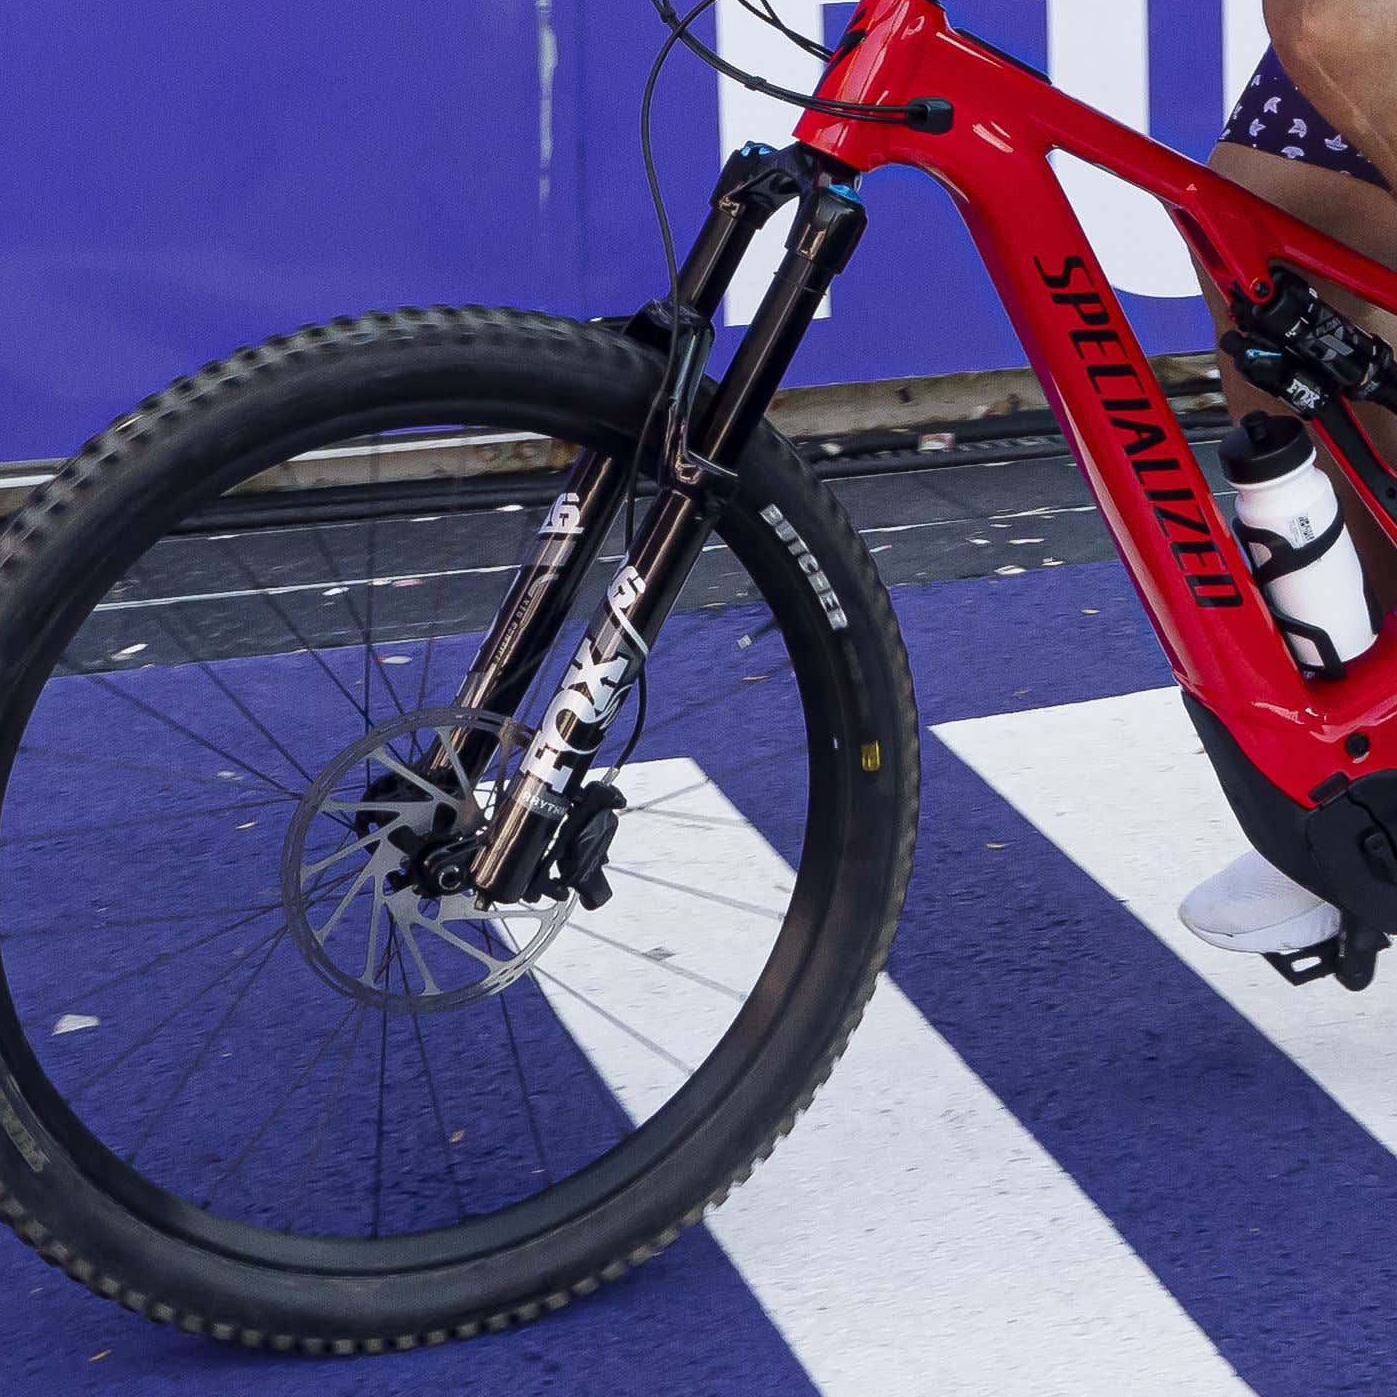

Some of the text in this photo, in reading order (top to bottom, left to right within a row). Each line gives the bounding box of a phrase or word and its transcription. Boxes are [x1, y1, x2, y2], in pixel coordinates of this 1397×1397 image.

[1034, 255, 1243, 609] SPECIALIZED
[1286, 378, 1320, 410] FOX
[759, 504, 850, 632] BUTCHER
[520, 638, 634, 794] FOX
